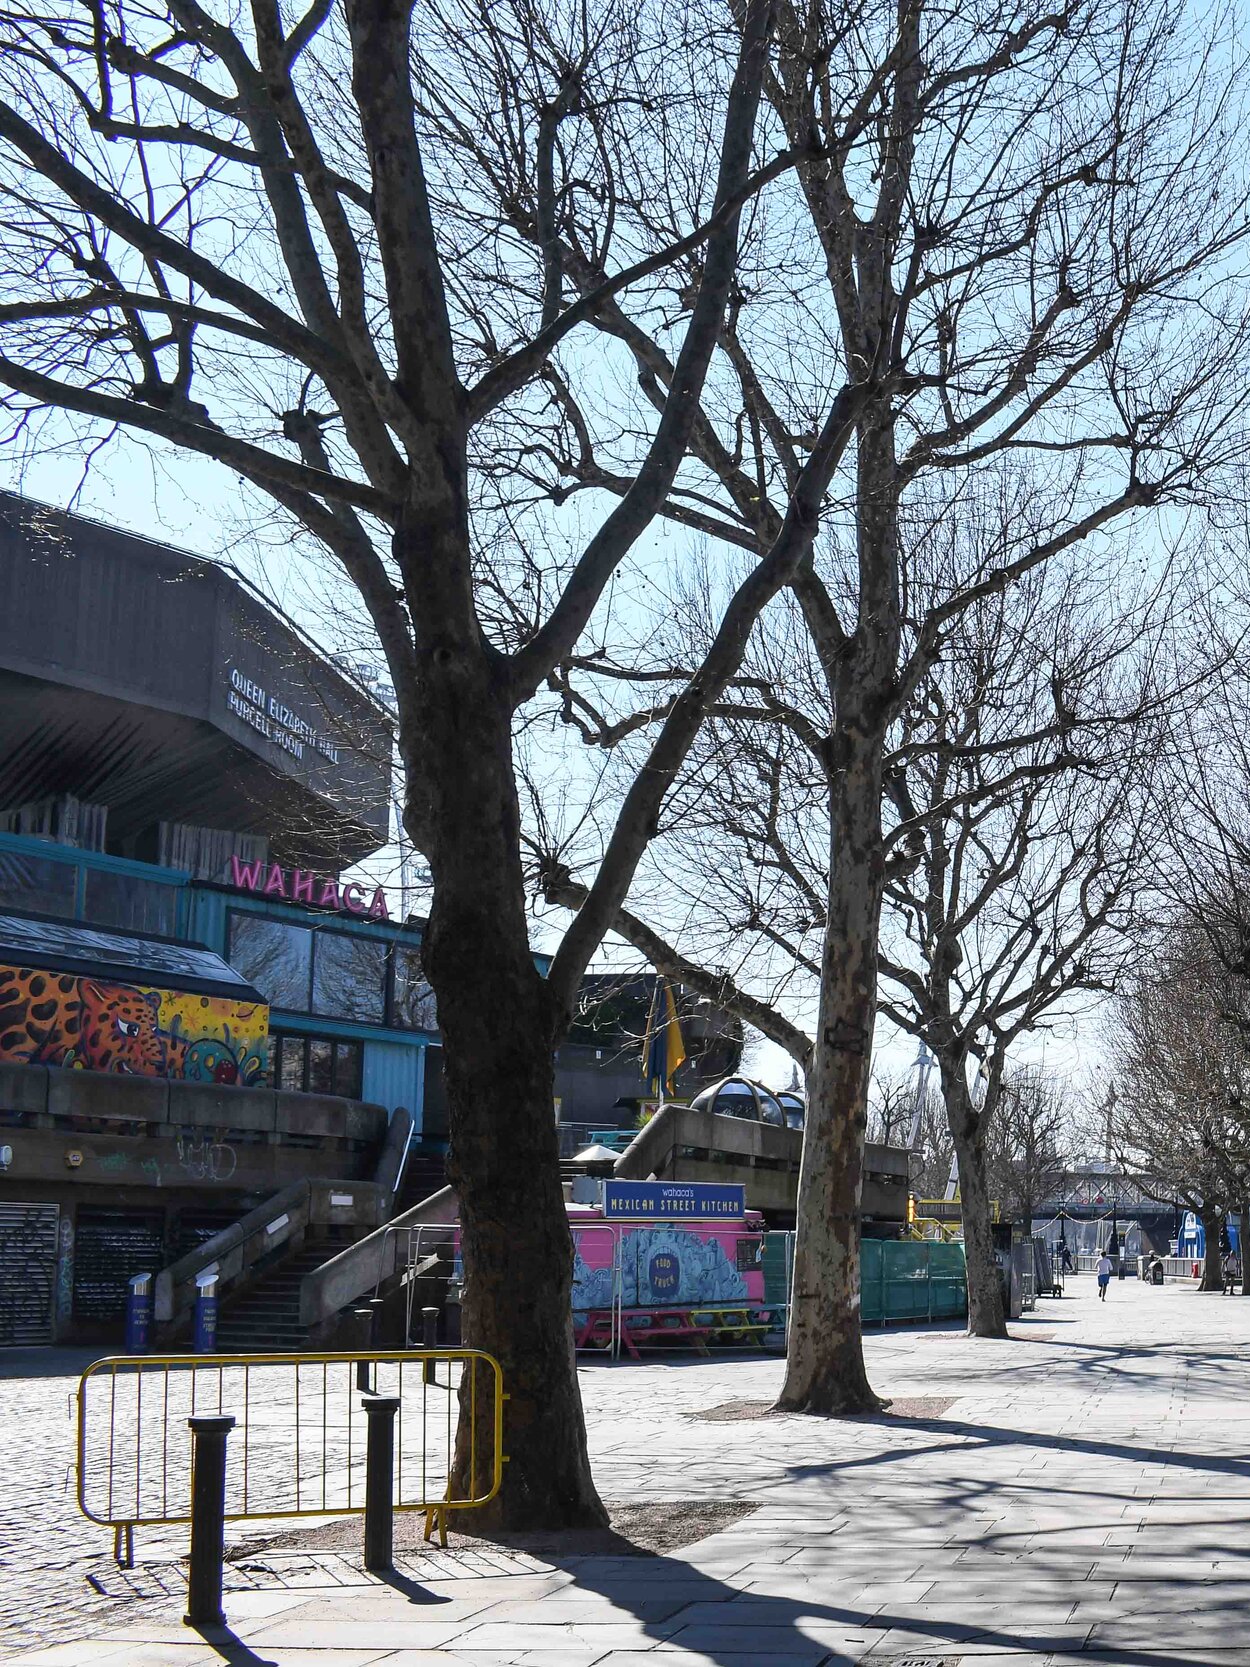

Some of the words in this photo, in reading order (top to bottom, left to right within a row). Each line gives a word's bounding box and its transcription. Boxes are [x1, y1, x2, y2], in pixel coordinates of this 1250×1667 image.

[230, 690, 271, 737] PURCELL
[231, 668, 265, 708] QUEEN
[270, 697, 316, 747] ELIZABETH
[230, 854, 390, 920] WAHACA
[662, 1187, 694, 1197] wahaca's
[611, 1198, 655, 1211] MEXICAN
[660, 1199, 695, 1211] STREET
[701, 1200, 739, 1212] KITCHEN
[655, 1257, 671, 1269] FOOD
[654, 1274, 675, 1288] TRUCK
